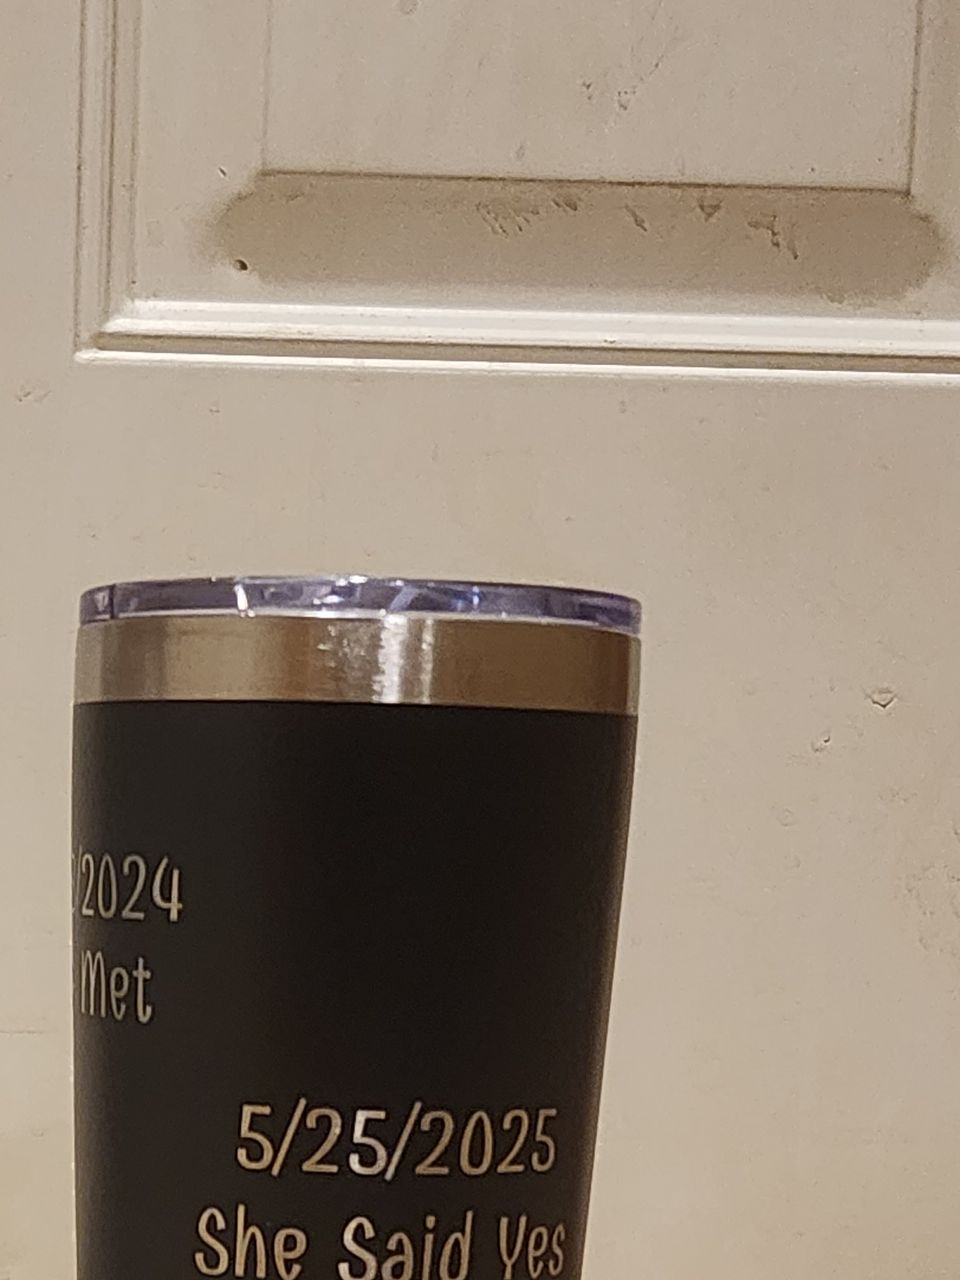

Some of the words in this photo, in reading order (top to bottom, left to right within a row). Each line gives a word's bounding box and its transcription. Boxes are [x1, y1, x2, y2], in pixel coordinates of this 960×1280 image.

[73, 845, 183, 922] /2024
[81, 949, 153, 1024] Met
[237, 1097, 557, 1182] 5/25/2025
[499, 1214, 566, 1280] Yes
